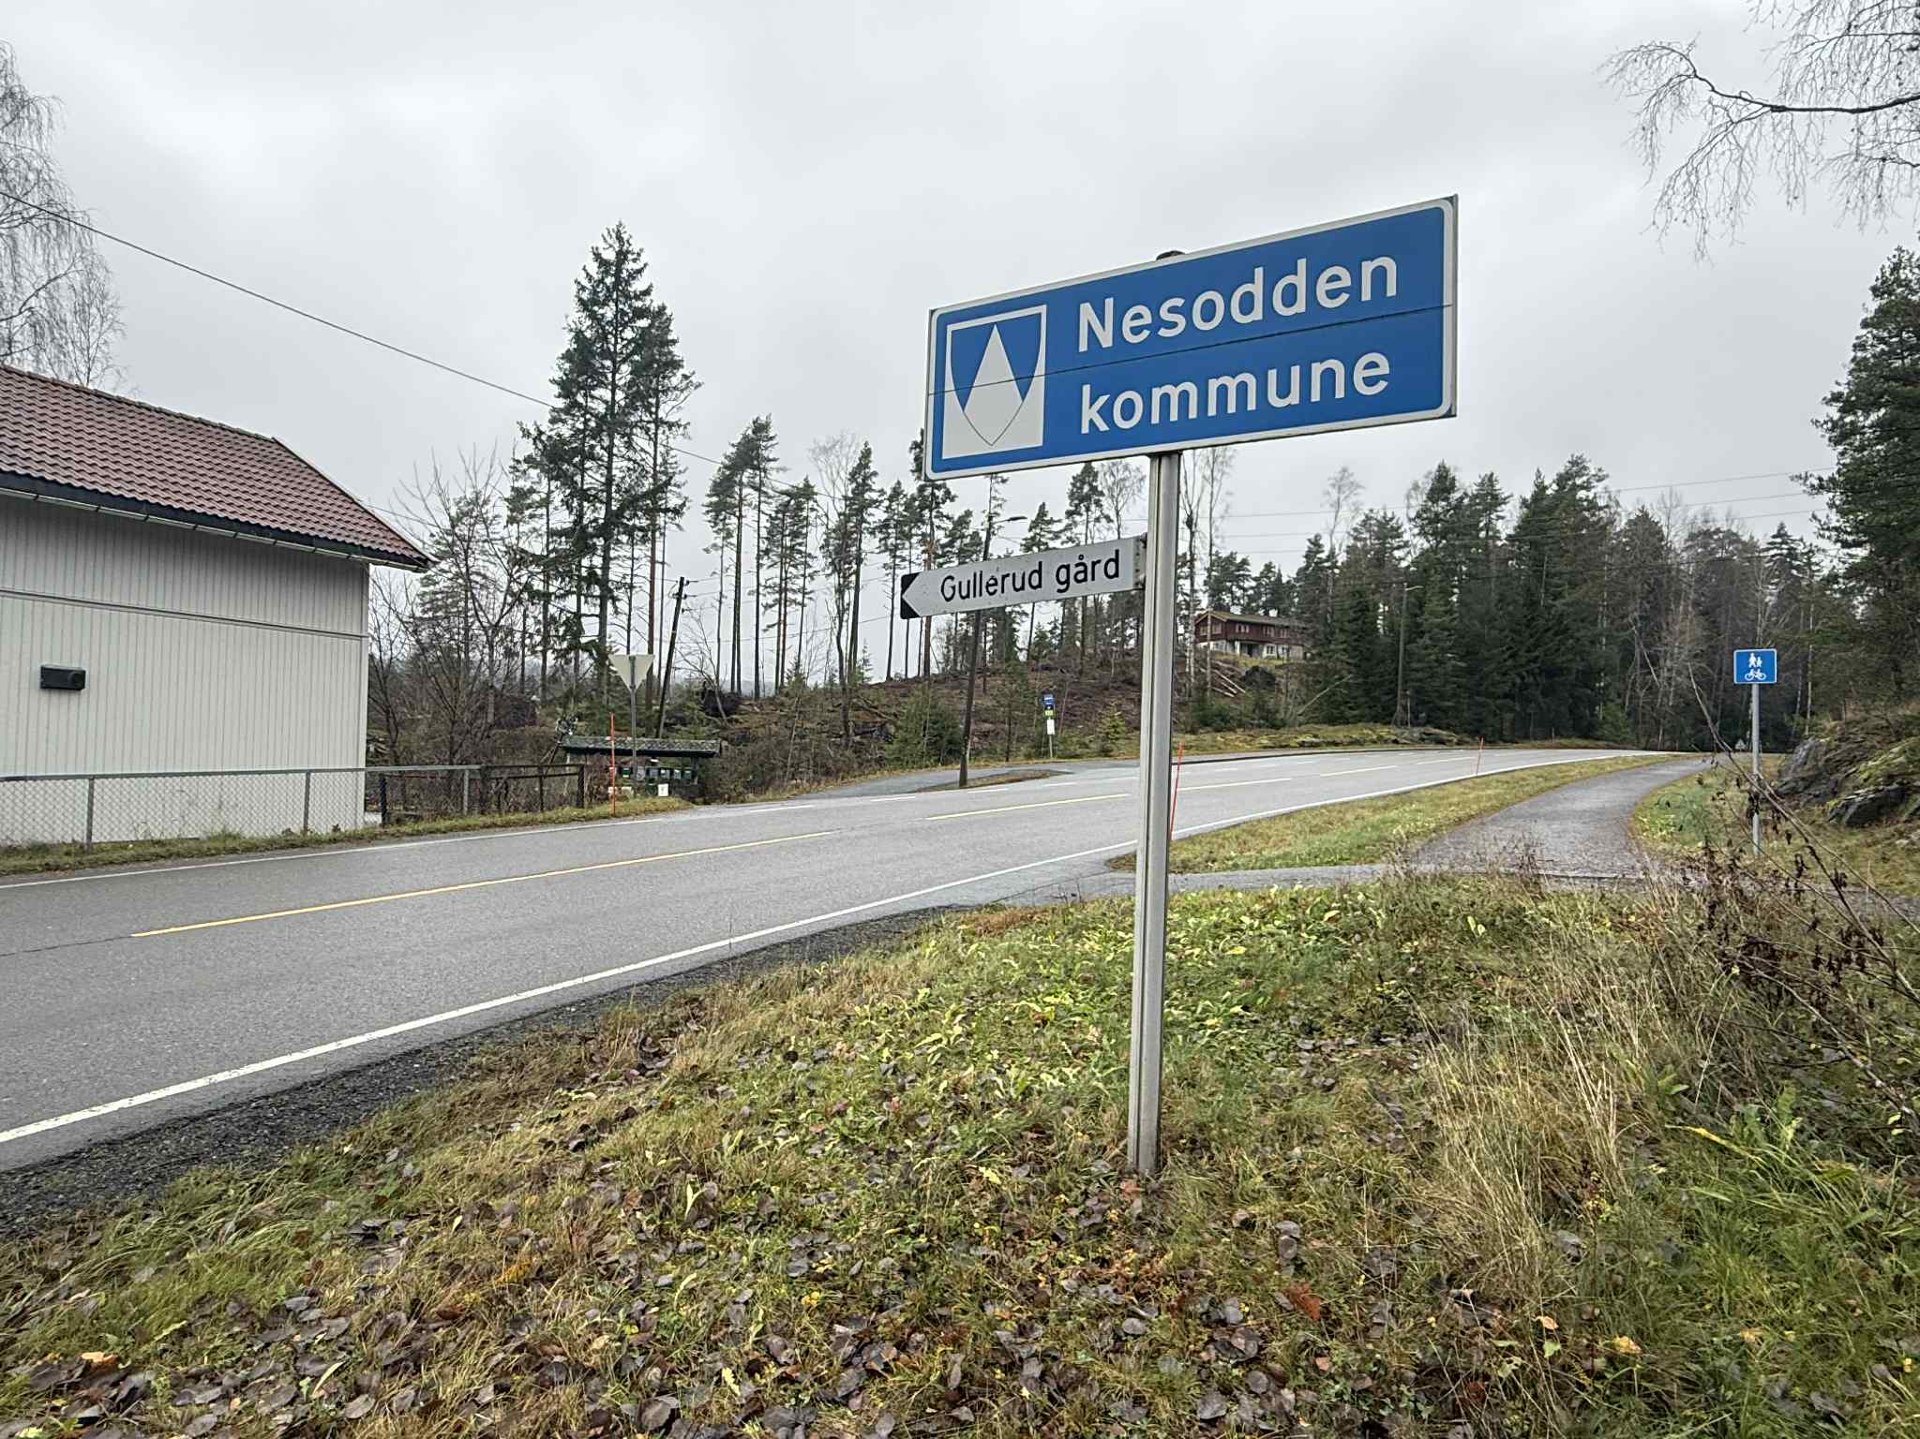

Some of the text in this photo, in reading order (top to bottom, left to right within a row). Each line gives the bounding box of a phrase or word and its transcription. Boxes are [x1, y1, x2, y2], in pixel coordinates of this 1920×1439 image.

[1078, 255, 1398, 352] Nesodden
[1081, 351, 1390, 434] kommune
[941, 549, 1120, 602] Gullerud gård
